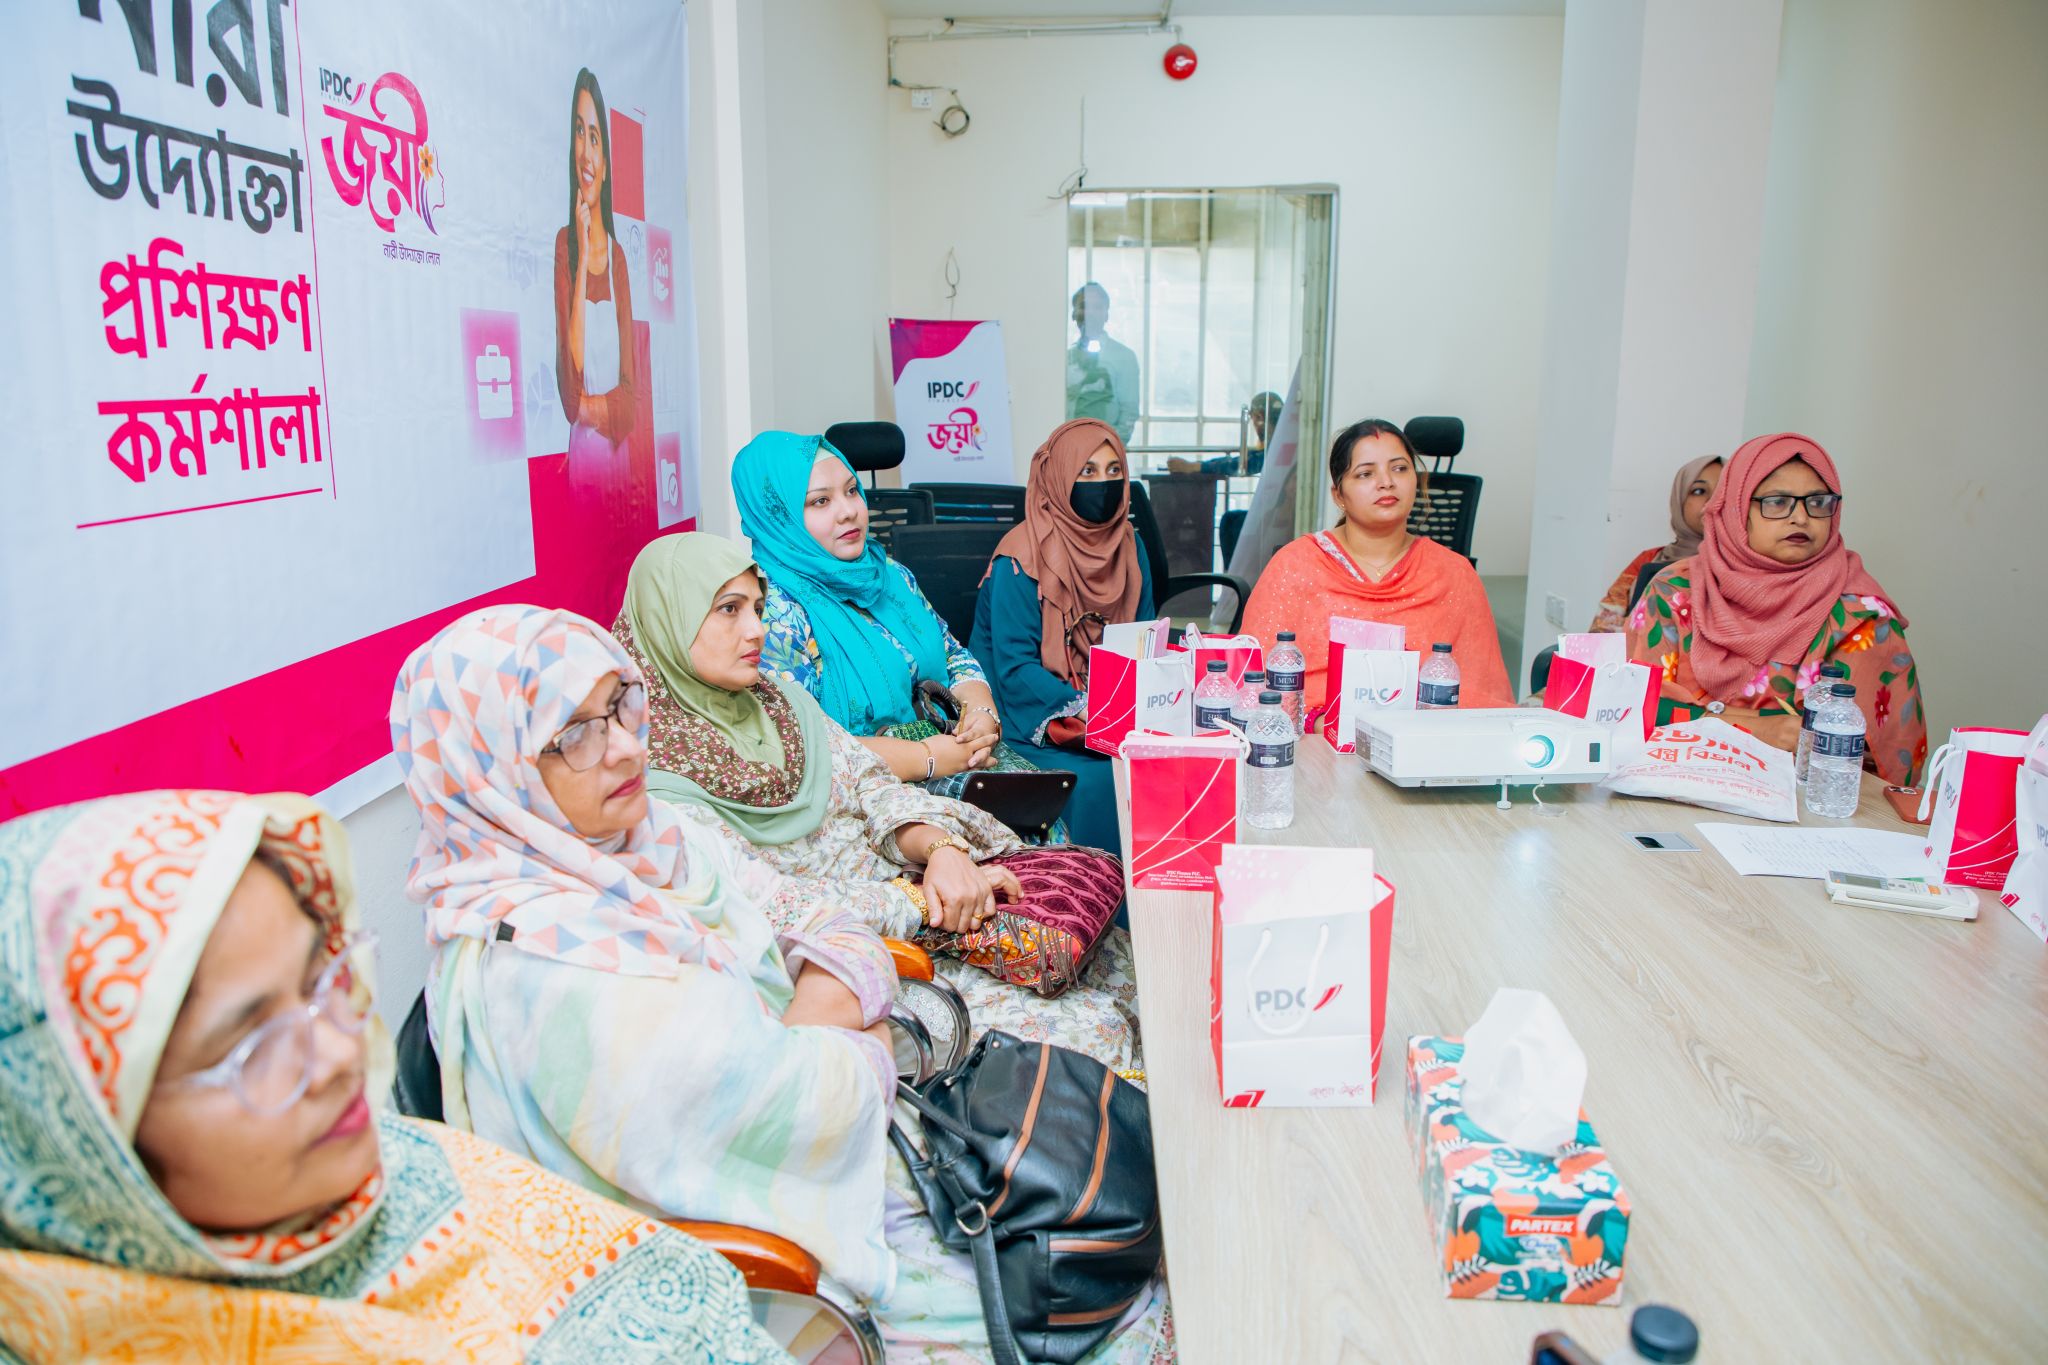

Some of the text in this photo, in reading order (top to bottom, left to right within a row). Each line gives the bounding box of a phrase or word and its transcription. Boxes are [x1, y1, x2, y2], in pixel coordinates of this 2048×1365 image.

[319, 67, 352, 101] IPDC
[66, 72, 304, 234] উদ্যোক্তা
[382, 240, 398, 260] নারী
[426, 251, 440, 266] লোন
[100, 236, 312, 359] প্রশিক্ষণ
[927, 381, 965, 399] IPDC
[97, 373, 322, 483] কর্মশালা
[927, 407, 978, 454] জয়ী
[1147, 692, 1174, 709] IPDC
[1595, 707, 1622, 723] IPDC
[1247, 986, 1306, 1012] PDC
[1510, 1218, 1574, 1232] PARTEX
